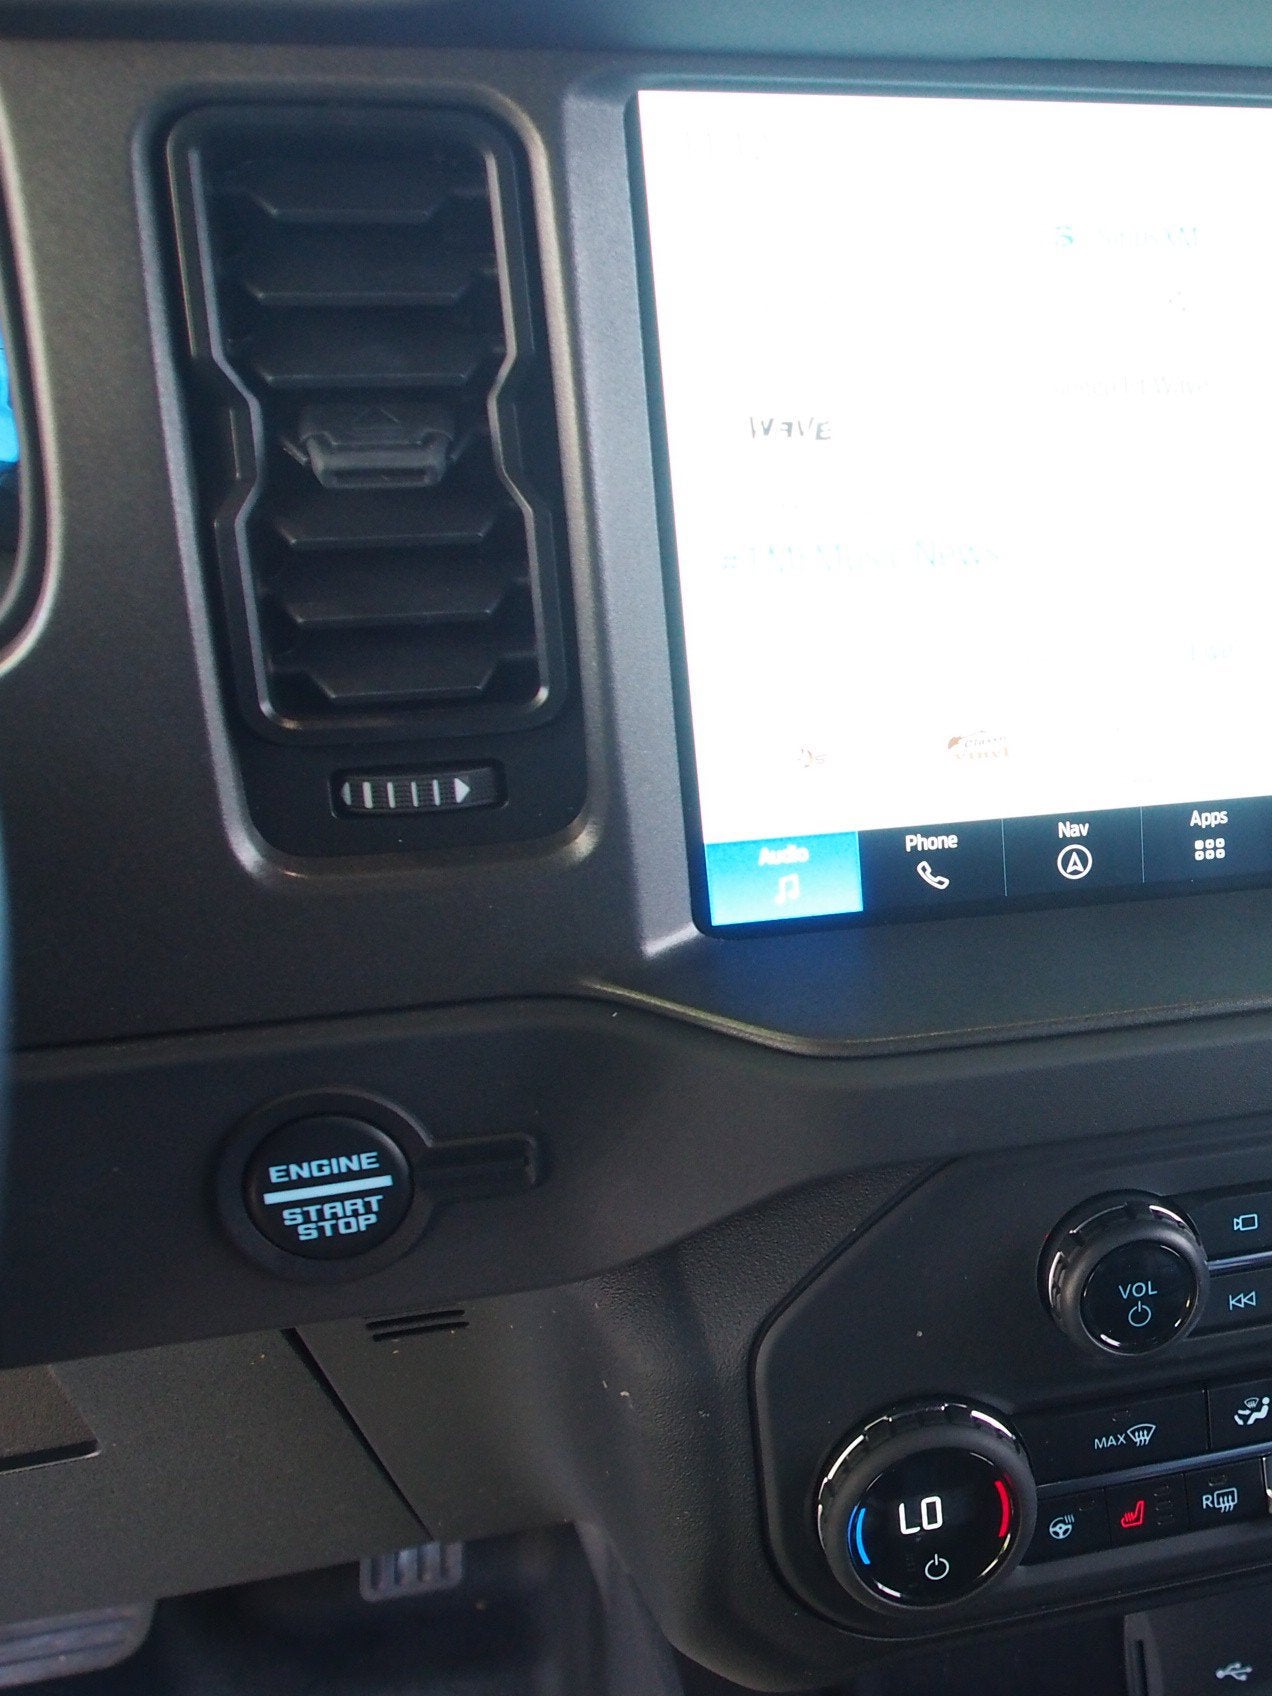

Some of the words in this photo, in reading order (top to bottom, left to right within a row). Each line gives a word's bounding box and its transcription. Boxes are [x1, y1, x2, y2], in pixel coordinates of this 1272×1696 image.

[1058, 820, 1090, 839] Nav
[1190, 809, 1229, 829] Apps
[905, 831, 958, 853] Phone
[758, 845, 810, 867] Audio
[268, 1151, 380, 1184] ENGINE
[281, 1194, 383, 1227] START
[296, 1212, 378, 1241] STOP
[1118, 1280, 1158, 1299] VOL
[1094, 1433, 1127, 1450] MAX
[898, 1495, 943, 1535] LO
